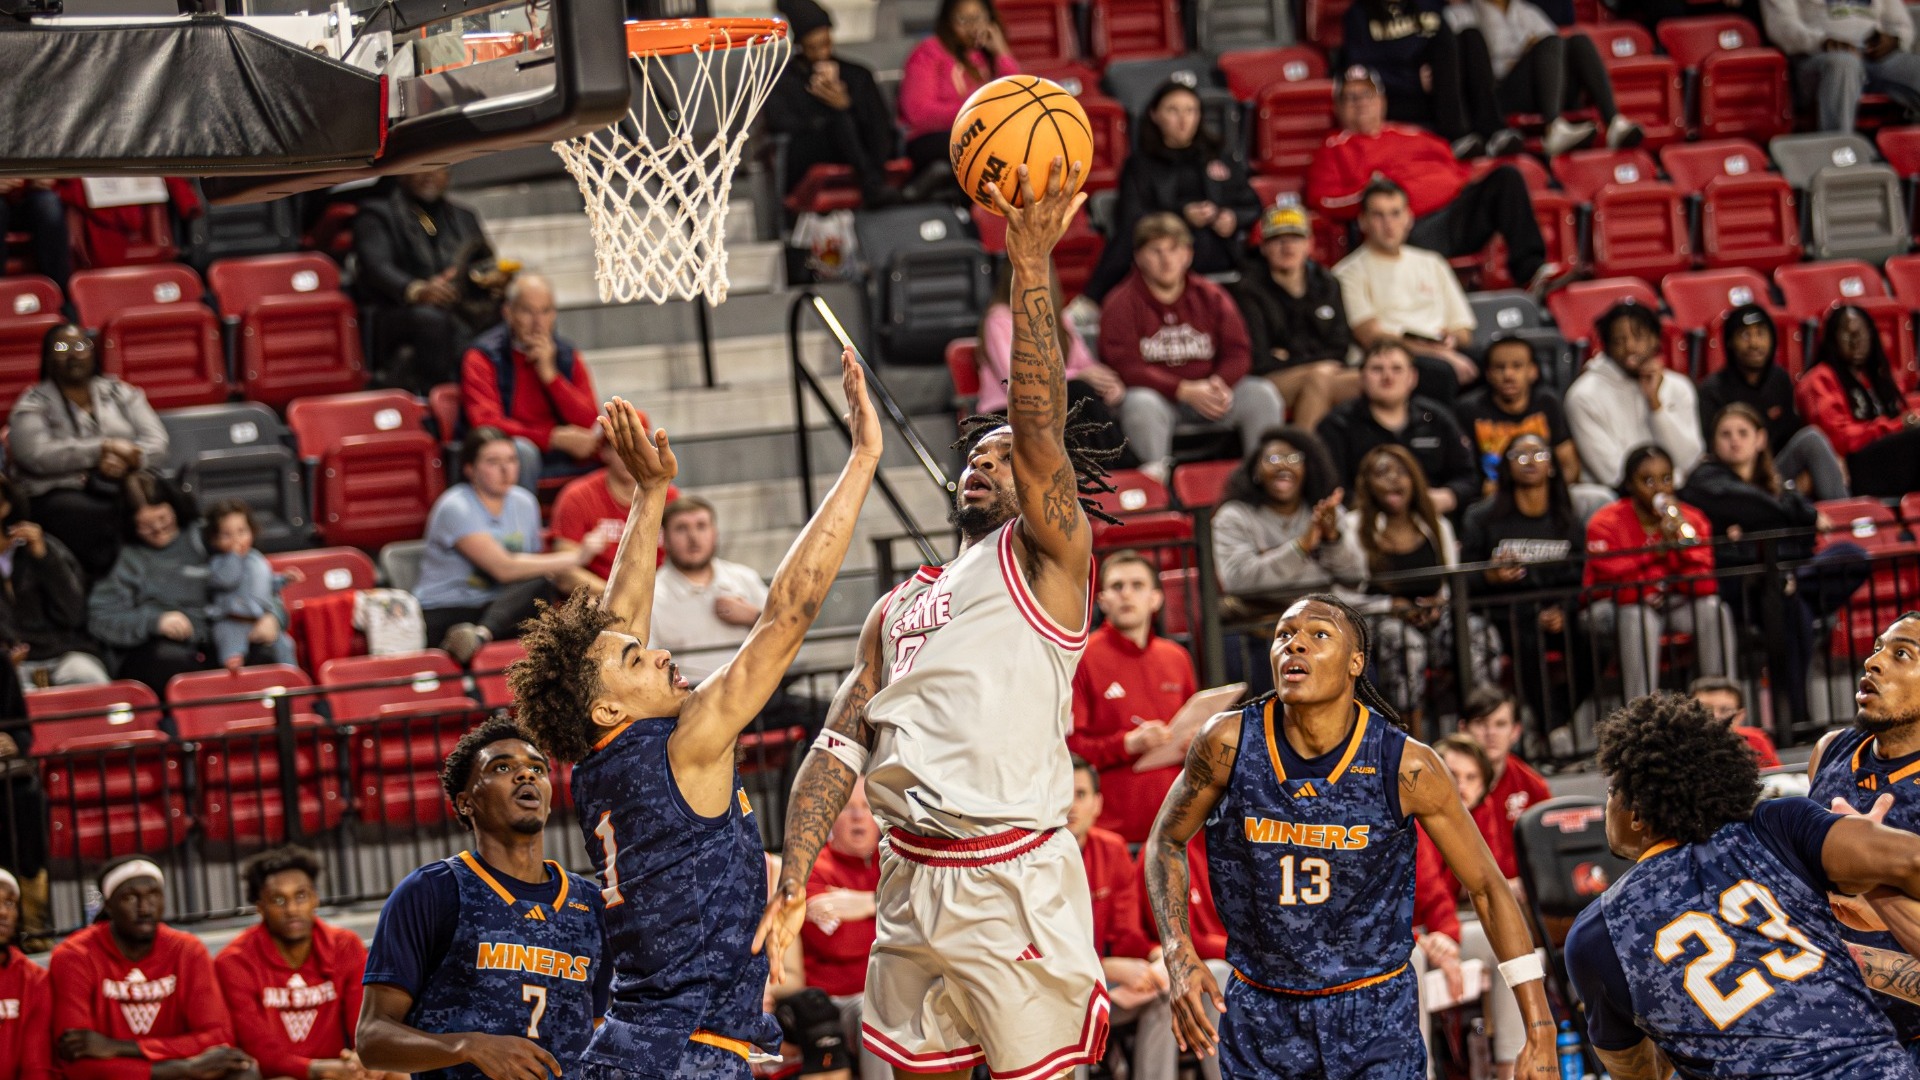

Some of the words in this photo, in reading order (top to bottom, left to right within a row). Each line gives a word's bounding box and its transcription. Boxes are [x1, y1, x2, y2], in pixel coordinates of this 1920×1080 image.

[890, 632, 927, 684] 0
[1244, 816, 1370, 850] MINERS
[594, 810, 625, 909] 1
[1279, 854, 1331, 906] 13
[476, 942, 591, 982] MINERS
[1653, 879, 1827, 1032] 23
[522, 984, 547, 1039] 7
